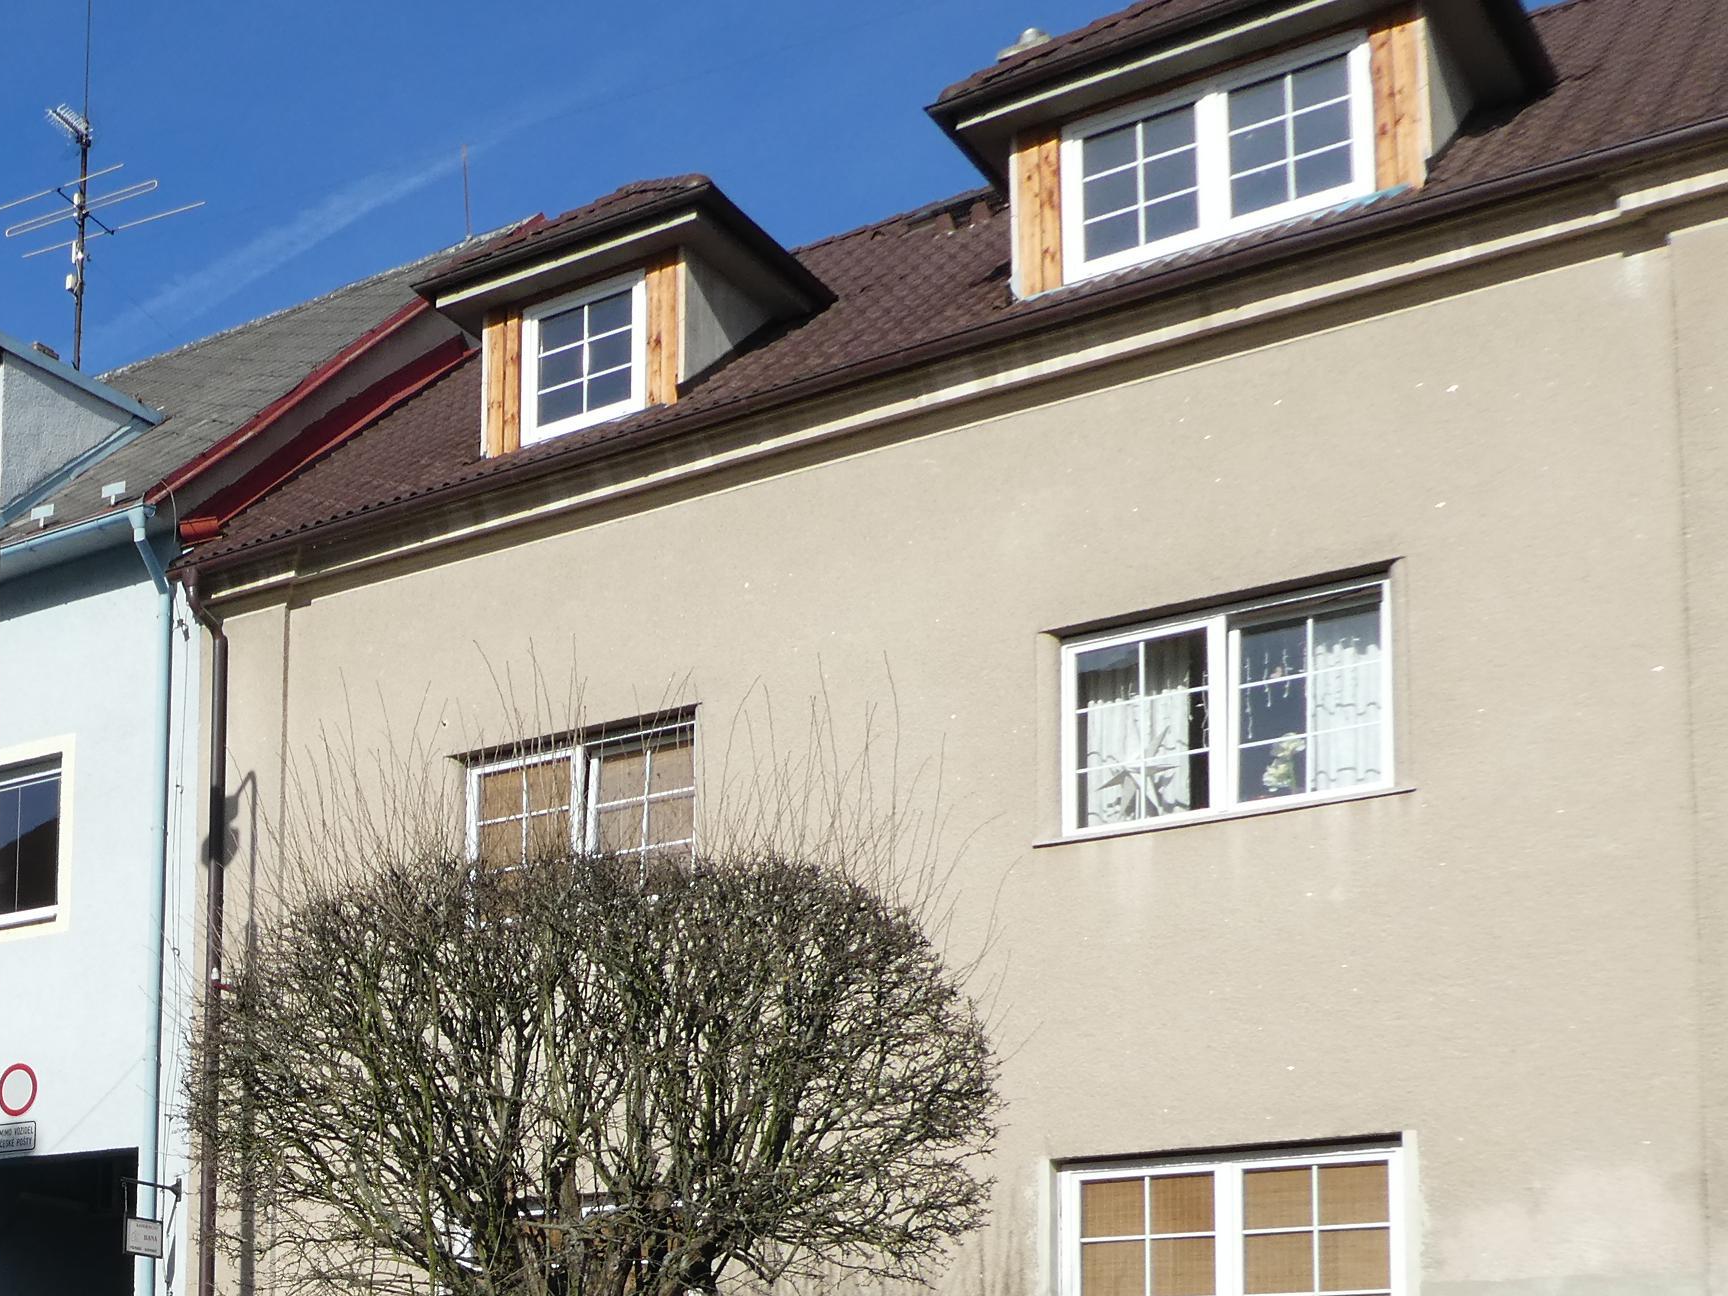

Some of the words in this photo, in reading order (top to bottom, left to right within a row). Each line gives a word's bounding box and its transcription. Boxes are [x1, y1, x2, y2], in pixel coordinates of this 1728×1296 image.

[0, 1128, 12, 1136] MIMO
[14, 1126, 33, 1135] VOZIDEL
[0, 1137, 15, 1148] ČESKÉ
